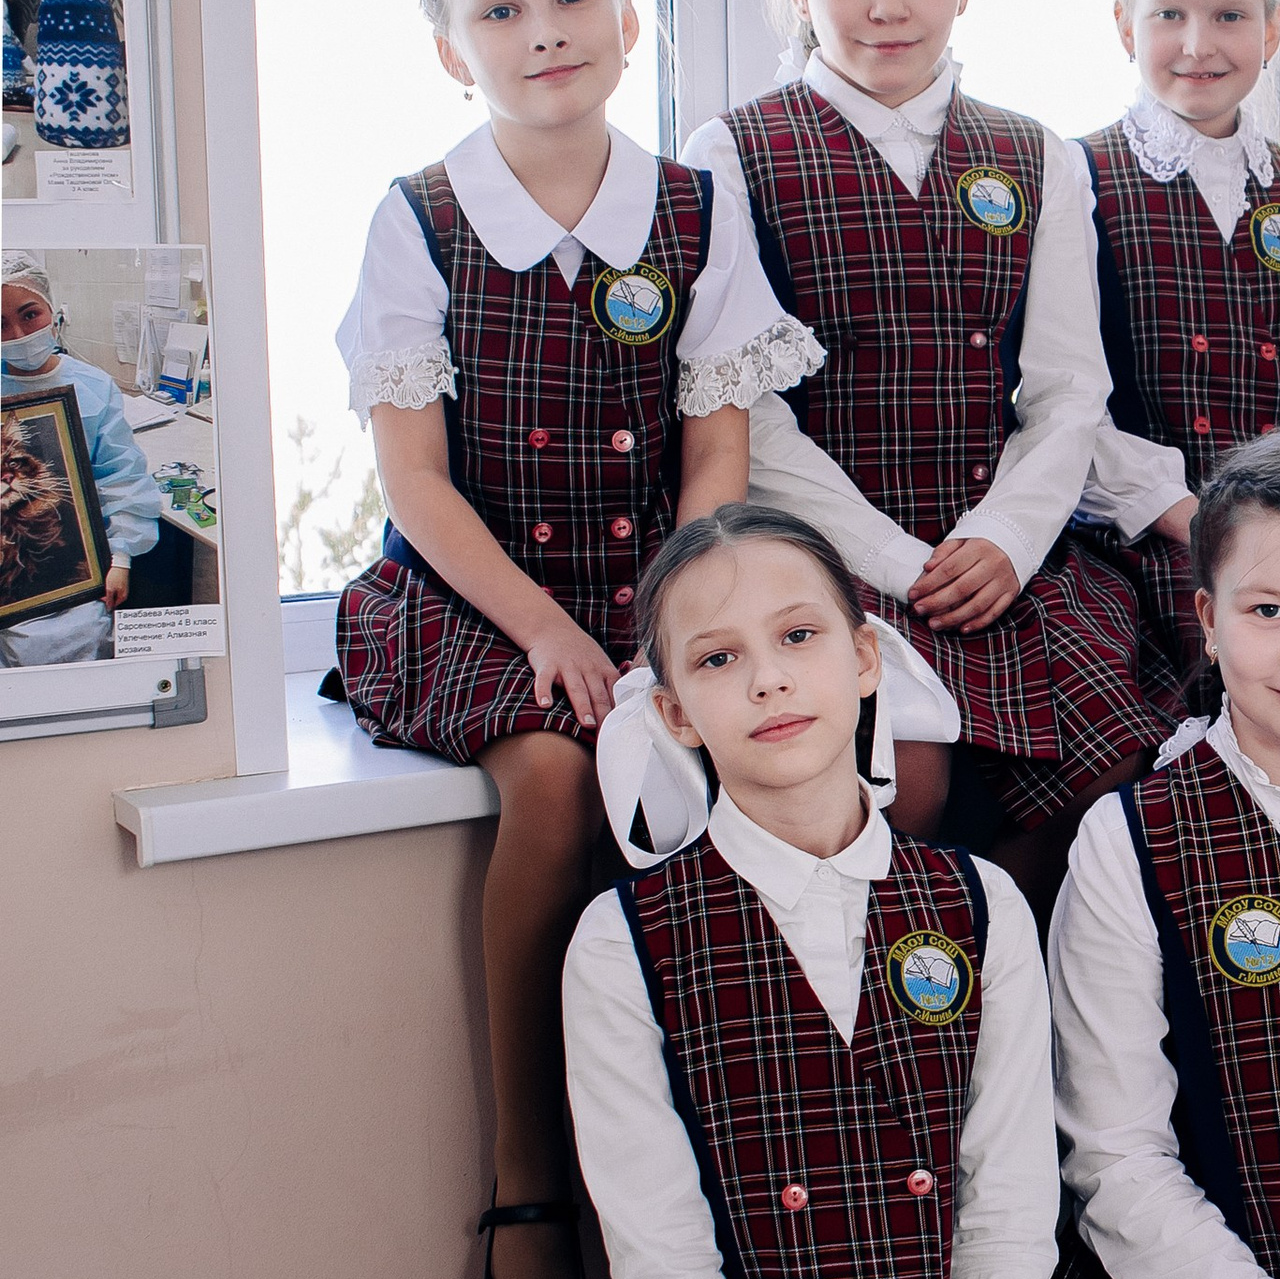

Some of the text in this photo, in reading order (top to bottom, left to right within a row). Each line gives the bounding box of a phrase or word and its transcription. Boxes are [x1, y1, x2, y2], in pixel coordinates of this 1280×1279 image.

[640, 267, 668, 290] СОШ
[118, 608, 190, 619] Танабаева Анара
[167, 630, 207, 639] Алмазная
[1216, 899, 1249, 928] МАОУ
[892, 934, 959, 963] МАОУ СОШ
